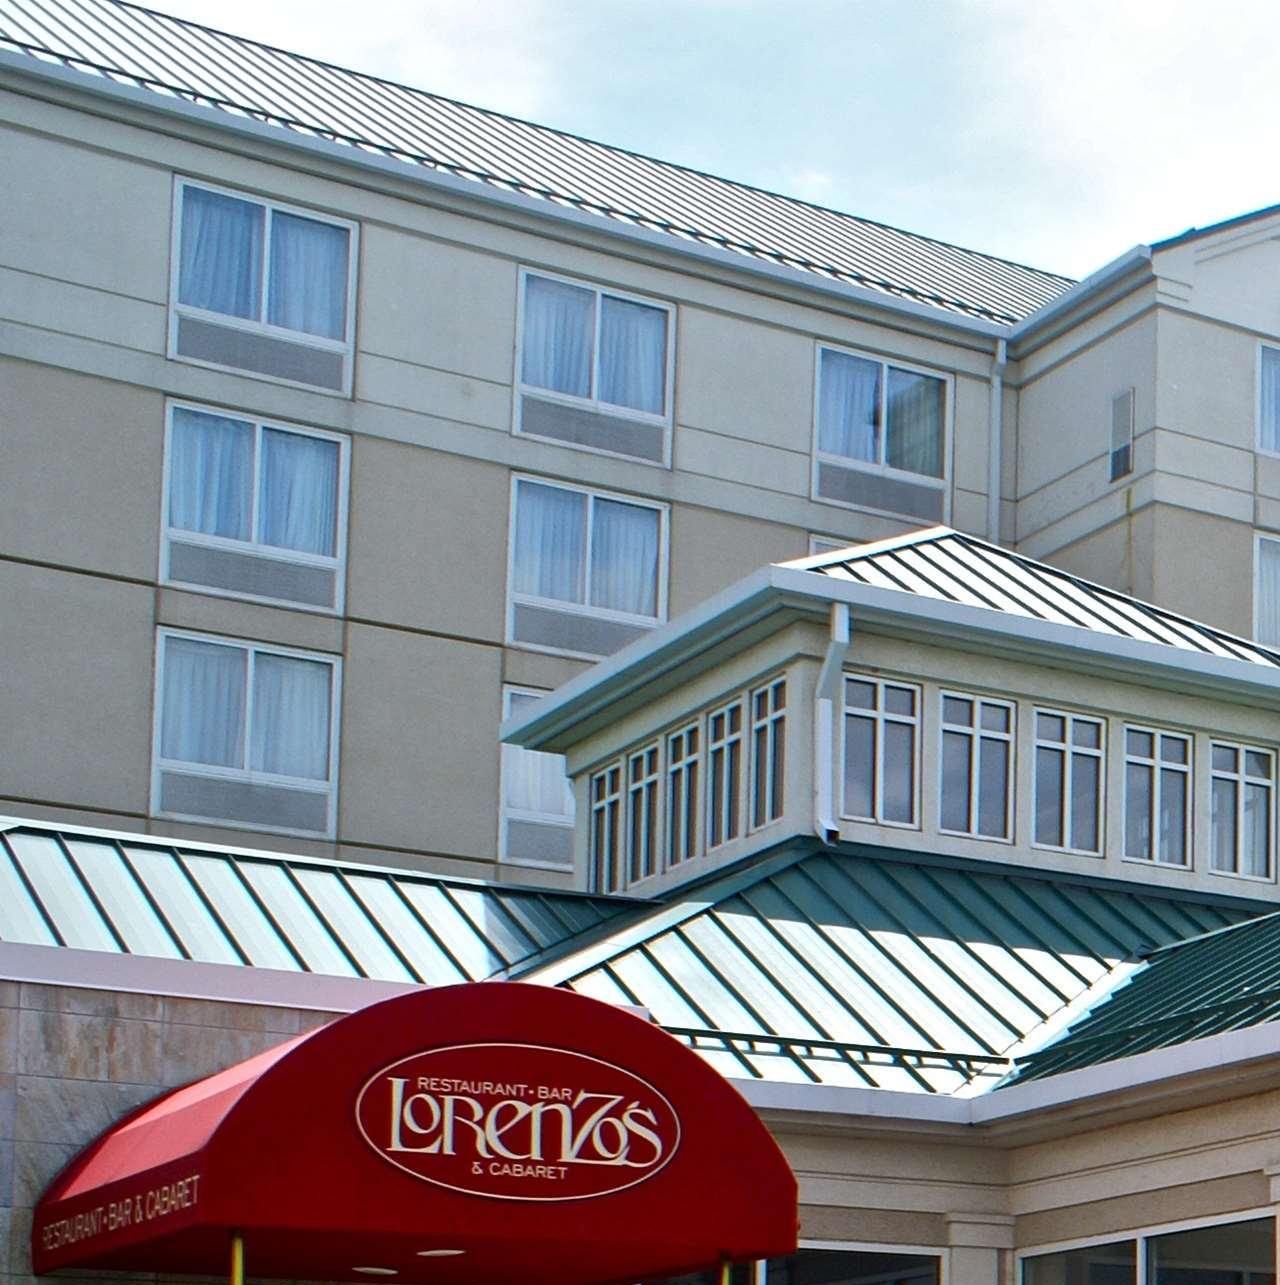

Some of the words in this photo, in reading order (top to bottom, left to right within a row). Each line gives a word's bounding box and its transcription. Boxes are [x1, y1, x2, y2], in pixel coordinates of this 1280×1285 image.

[417, 1077, 528, 1097] RESTAURANT
[537, 1085, 573, 1100] BAR
[472, 1162, 484, 1175] &
[490, 1162, 568, 1179] CABARET
[108, 1198, 132, 1231] BAR
[135, 1195, 143, 1223] &
[146, 1174, 200, 1220] CABARET
